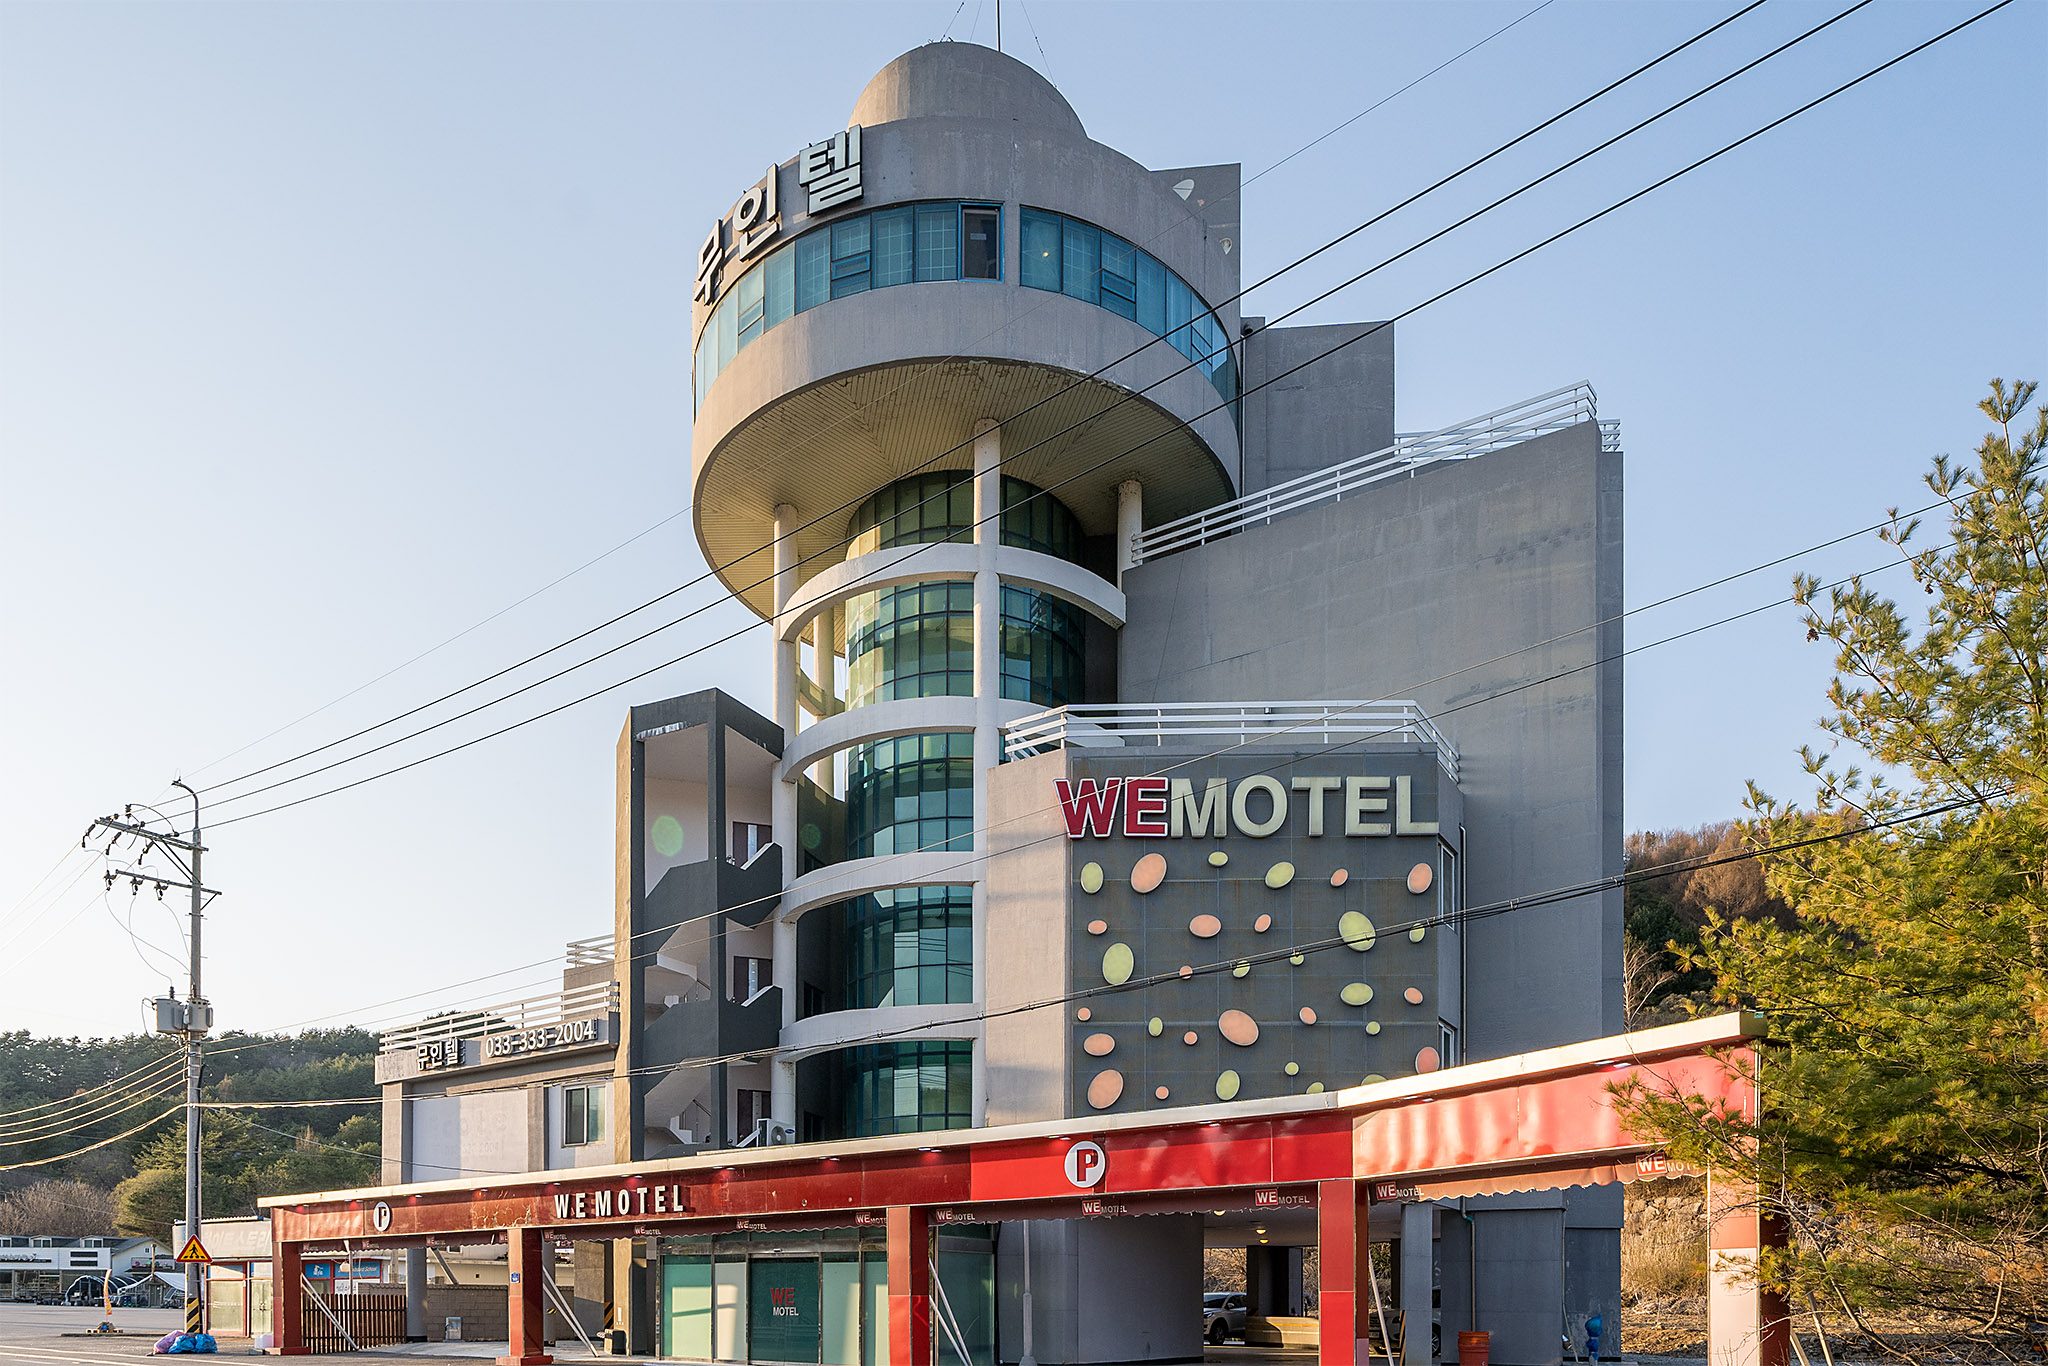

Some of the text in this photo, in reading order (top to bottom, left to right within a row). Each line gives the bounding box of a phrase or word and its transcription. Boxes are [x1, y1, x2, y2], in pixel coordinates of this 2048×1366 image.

[693, 124, 863, 306] 무인텔
[485, 1018, 598, 1058] 033-333-2004
[417, 1037, 461, 1071] 무인텔
[1077, 1149, 1098, 1182] P
[1638, 1155, 1665, 1172] WE
[1377, 1185, 1425, 1197] WE MOTEL
[1256, 1191, 1310, 1205] WE MOTEL
[1083, 1201, 1100, 1213] WE
[856, 1213, 869, 1223] WE
[937, 1210, 975, 1221] WE MOTEL
[634, 1225, 645, 1235] WE
[737, 1220, 749, 1229] WE
[770, 1287, 795, 1305] WE
[772, 1306, 800, 1316] MOTEL
